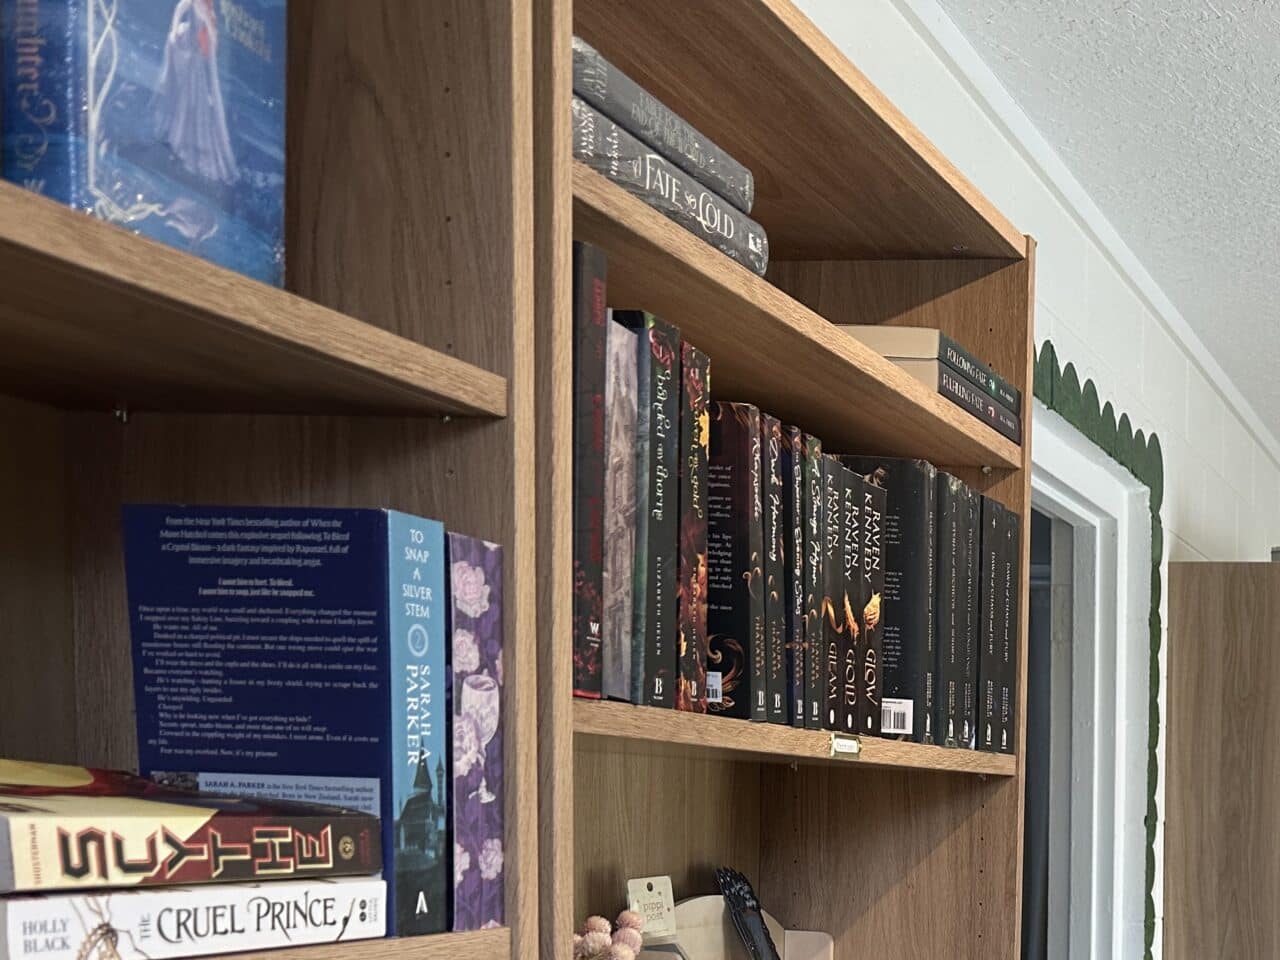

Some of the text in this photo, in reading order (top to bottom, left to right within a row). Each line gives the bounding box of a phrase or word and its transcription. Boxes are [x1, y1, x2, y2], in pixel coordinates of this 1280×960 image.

[645, 154, 683, 210] FATE
[697, 192, 735, 239] COLD
[410, 529, 424, 544] TO
[826, 473, 834, 560] KENNEDY
[832, 490, 840, 547] RAVEN
[843, 487, 852, 581] KENNEDY
[851, 505, 860, 567] RAVEN
[864, 492, 872, 583] KENNEDY
[872, 510, 880, 570] RAVEN
[404, 546, 430, 564] SNAP
[413, 568, 421, 581] A
[402, 583, 432, 602] SILVER
[405, 603, 430, 619] STEM
[419, 665, 431, 738] SARAH
[864, 648, 878, 707] GLOW
[406, 663, 420, 765] PARKER
[238, 782, 266, 790] PARKER
[57, 824, 333, 881] SCYTHE
[22, 918, 69, 936] HOLLY
[23, 935, 71, 954] BLACK
[157, 907, 246, 944] CRUEL
[247, 889, 338, 938] PRINCE
